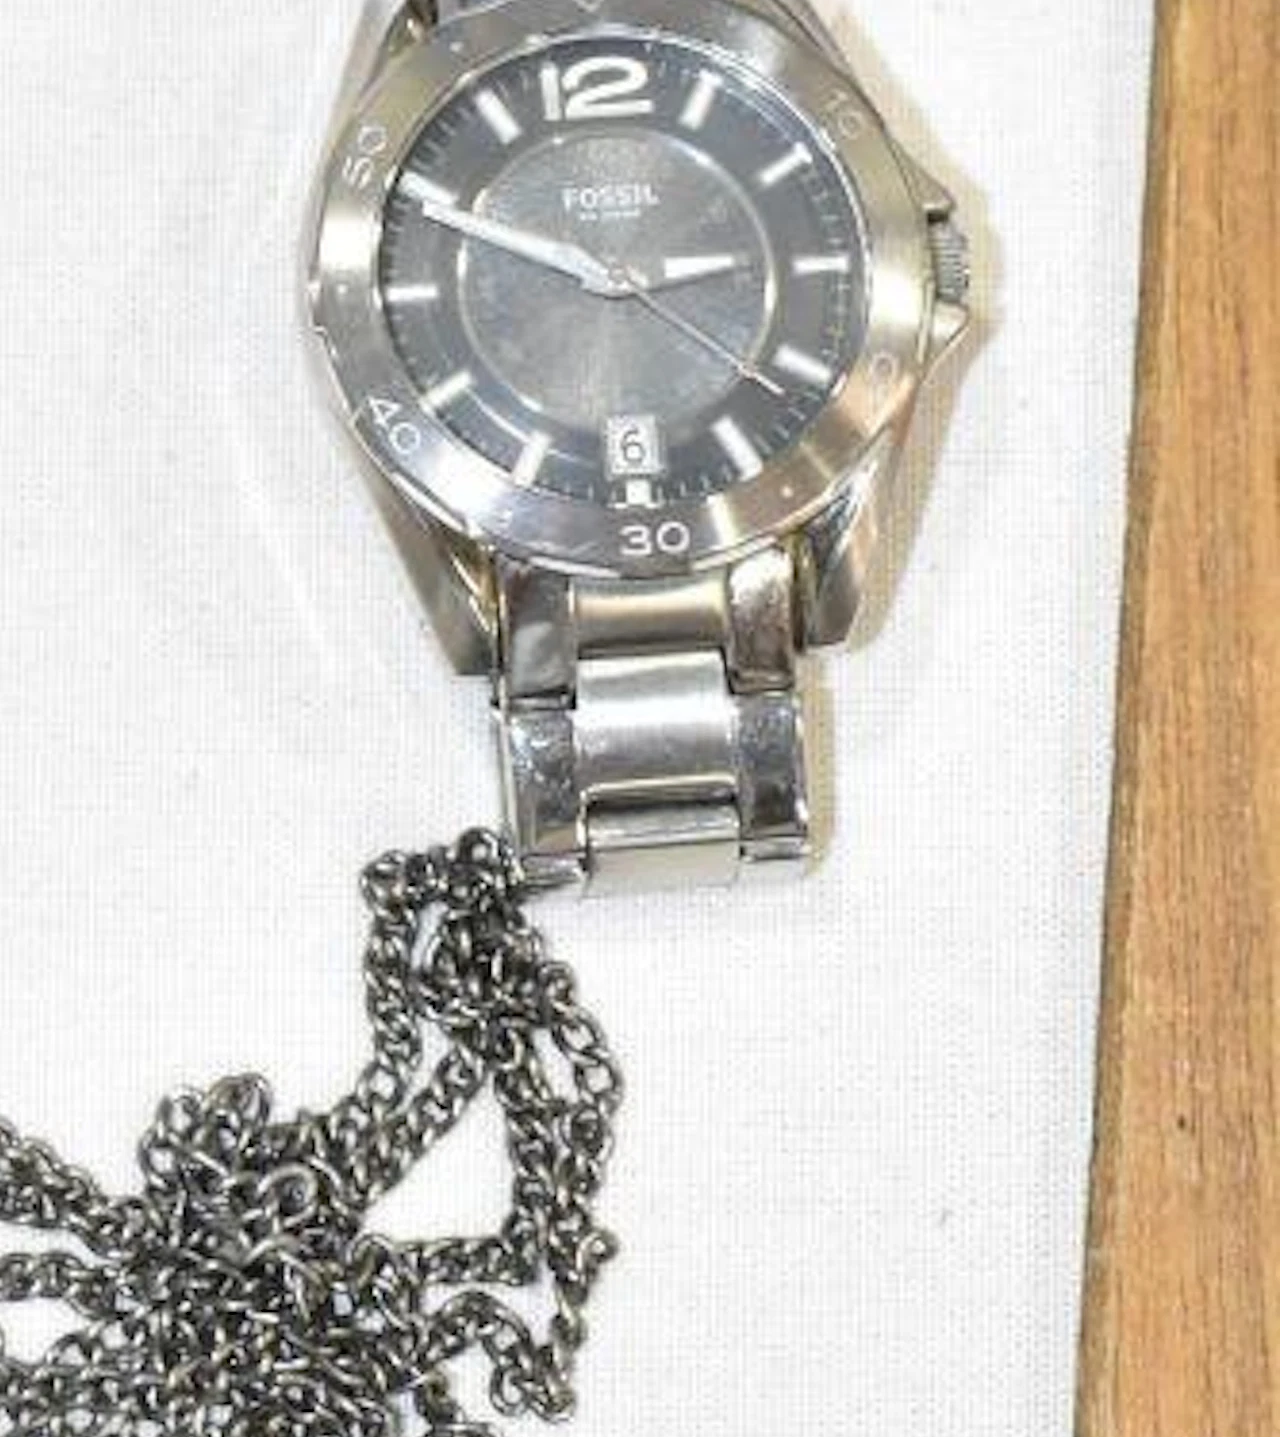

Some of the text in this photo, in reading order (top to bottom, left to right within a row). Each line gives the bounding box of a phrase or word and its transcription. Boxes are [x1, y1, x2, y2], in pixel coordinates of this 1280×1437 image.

[540, 56, 655, 122] 12
[561, 183, 661, 211] FOSSIL
[367, 394, 423, 457] 40
[620, 428, 644, 463] 6
[618, 520, 690, 556] 30
